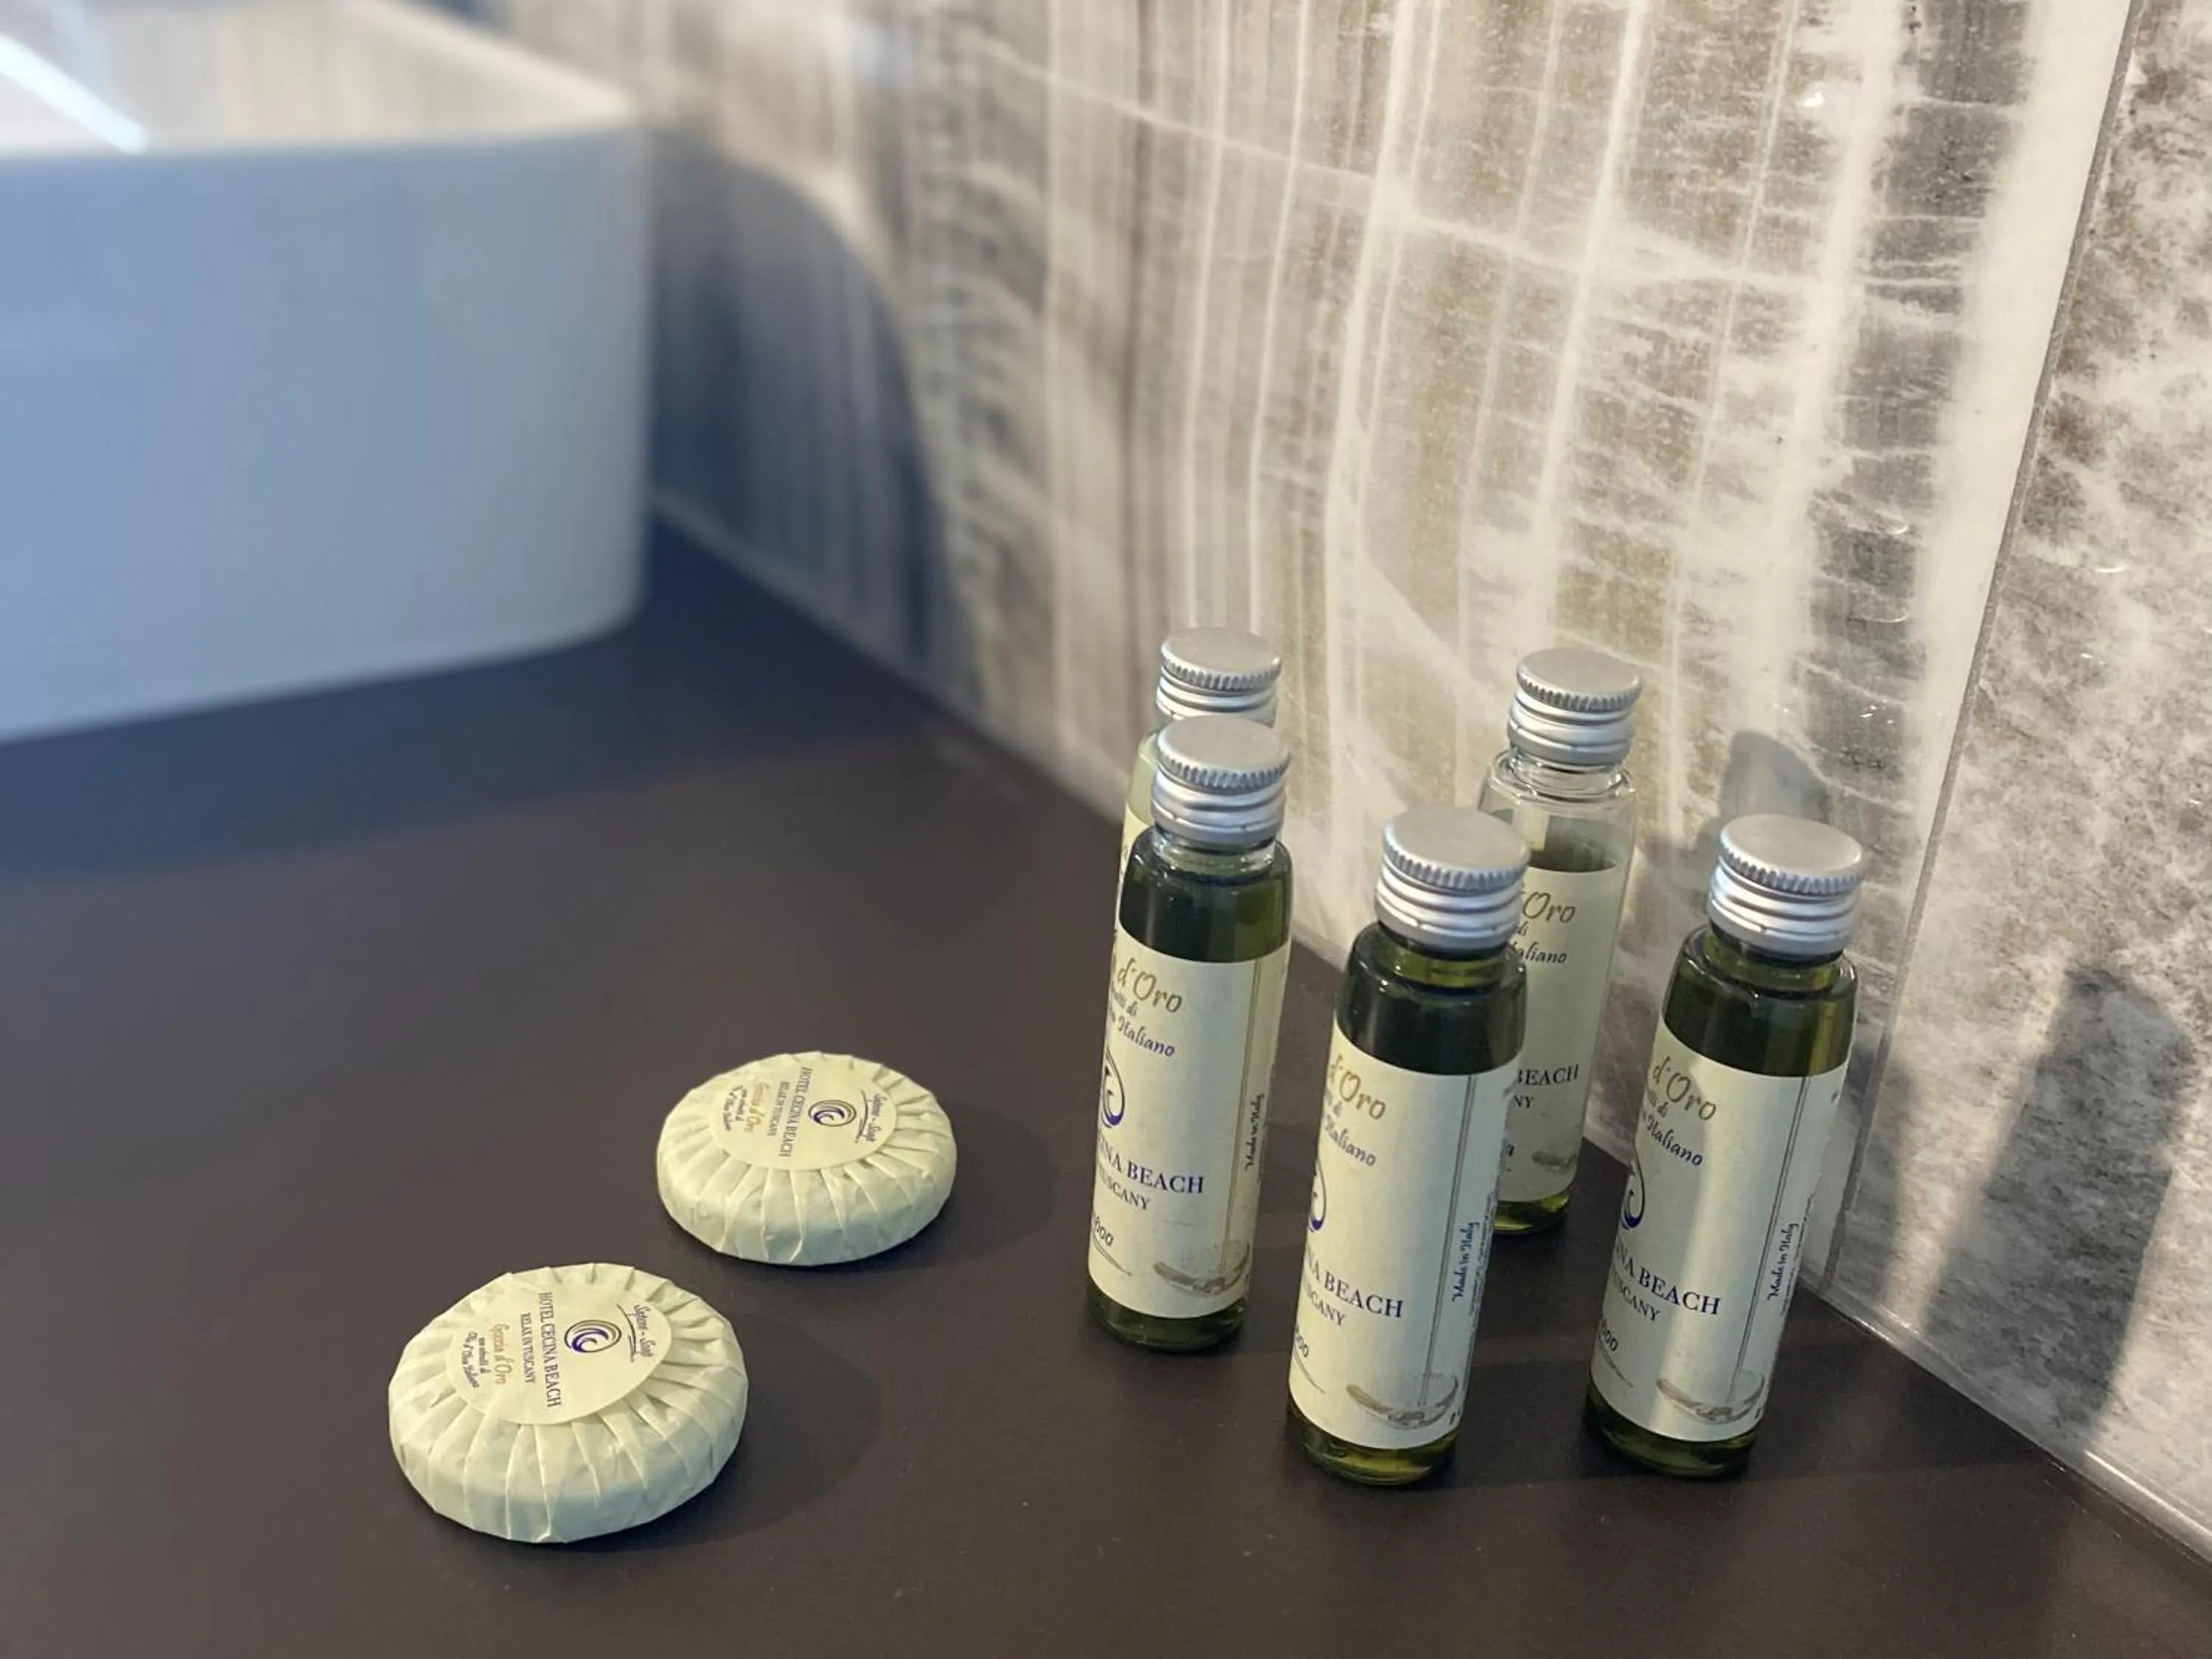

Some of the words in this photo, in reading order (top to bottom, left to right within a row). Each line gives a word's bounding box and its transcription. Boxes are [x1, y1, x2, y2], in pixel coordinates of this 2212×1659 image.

[1117, 1016, 1175, 1057] Italiano
[795, 1066, 813, 1093] HOTEL
[779, 1125, 799, 1157] BEACH
[1646, 1114, 1704, 1166] Italiano
[1127, 1158, 1206, 1194] BEACH
[1459, 1221, 1481, 1252] Italy
[1767, 1265, 1785, 1301] Made
[1778, 1222, 1800, 1252] Italy
[1324, 1270, 1405, 1318] BEACH
[1451, 1265, 1469, 1303] Made
[1638, 1266, 1722, 1315] BEACH
[538, 1292, 554, 1324] HOTEL
[540, 1324, 557, 1364] CECINA
[523, 1345, 536, 1383] TUSCANY
[544, 1364, 562, 1408] BEACH
